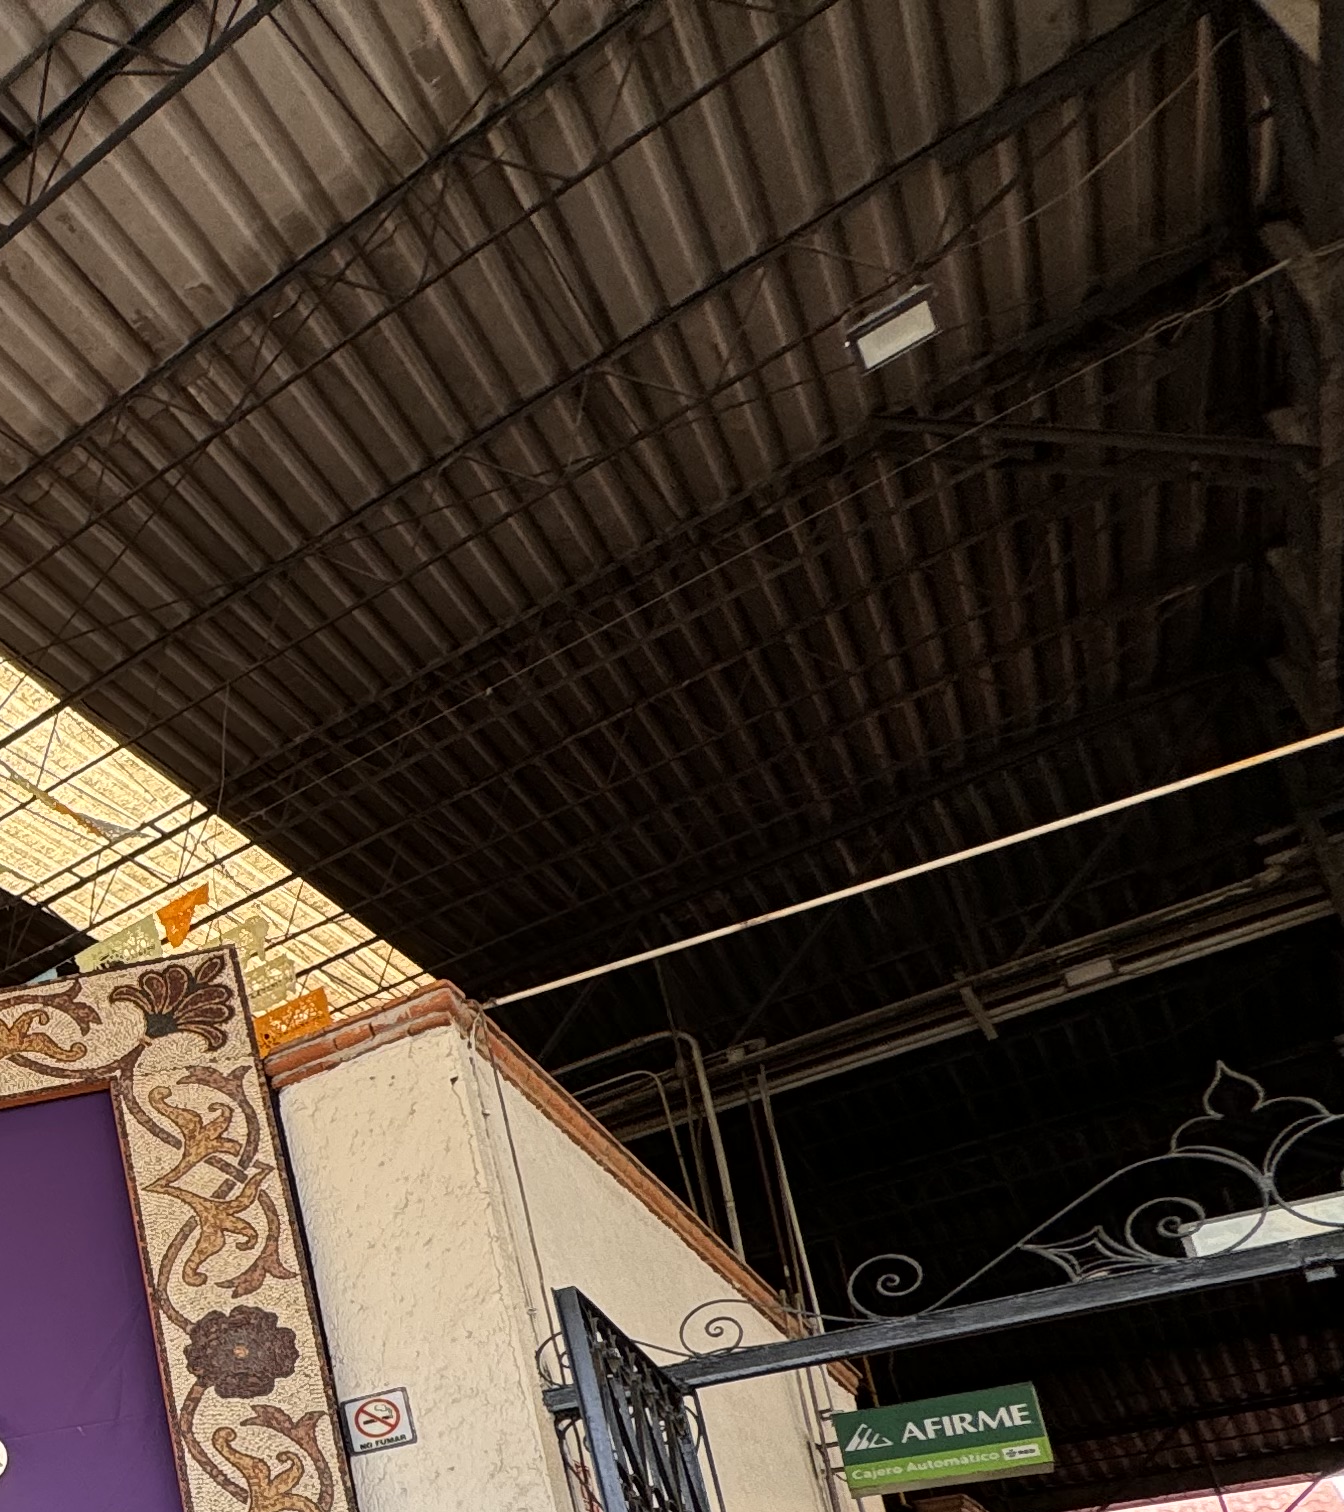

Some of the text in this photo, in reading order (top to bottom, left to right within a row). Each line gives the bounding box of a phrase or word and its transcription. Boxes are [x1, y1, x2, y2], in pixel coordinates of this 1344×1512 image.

[901, 1403, 1032, 1444] AFIRME
[360, 1434, 407, 1450] NO FUMAR
[851, 1451, 1000, 1480] Cajero Automático
